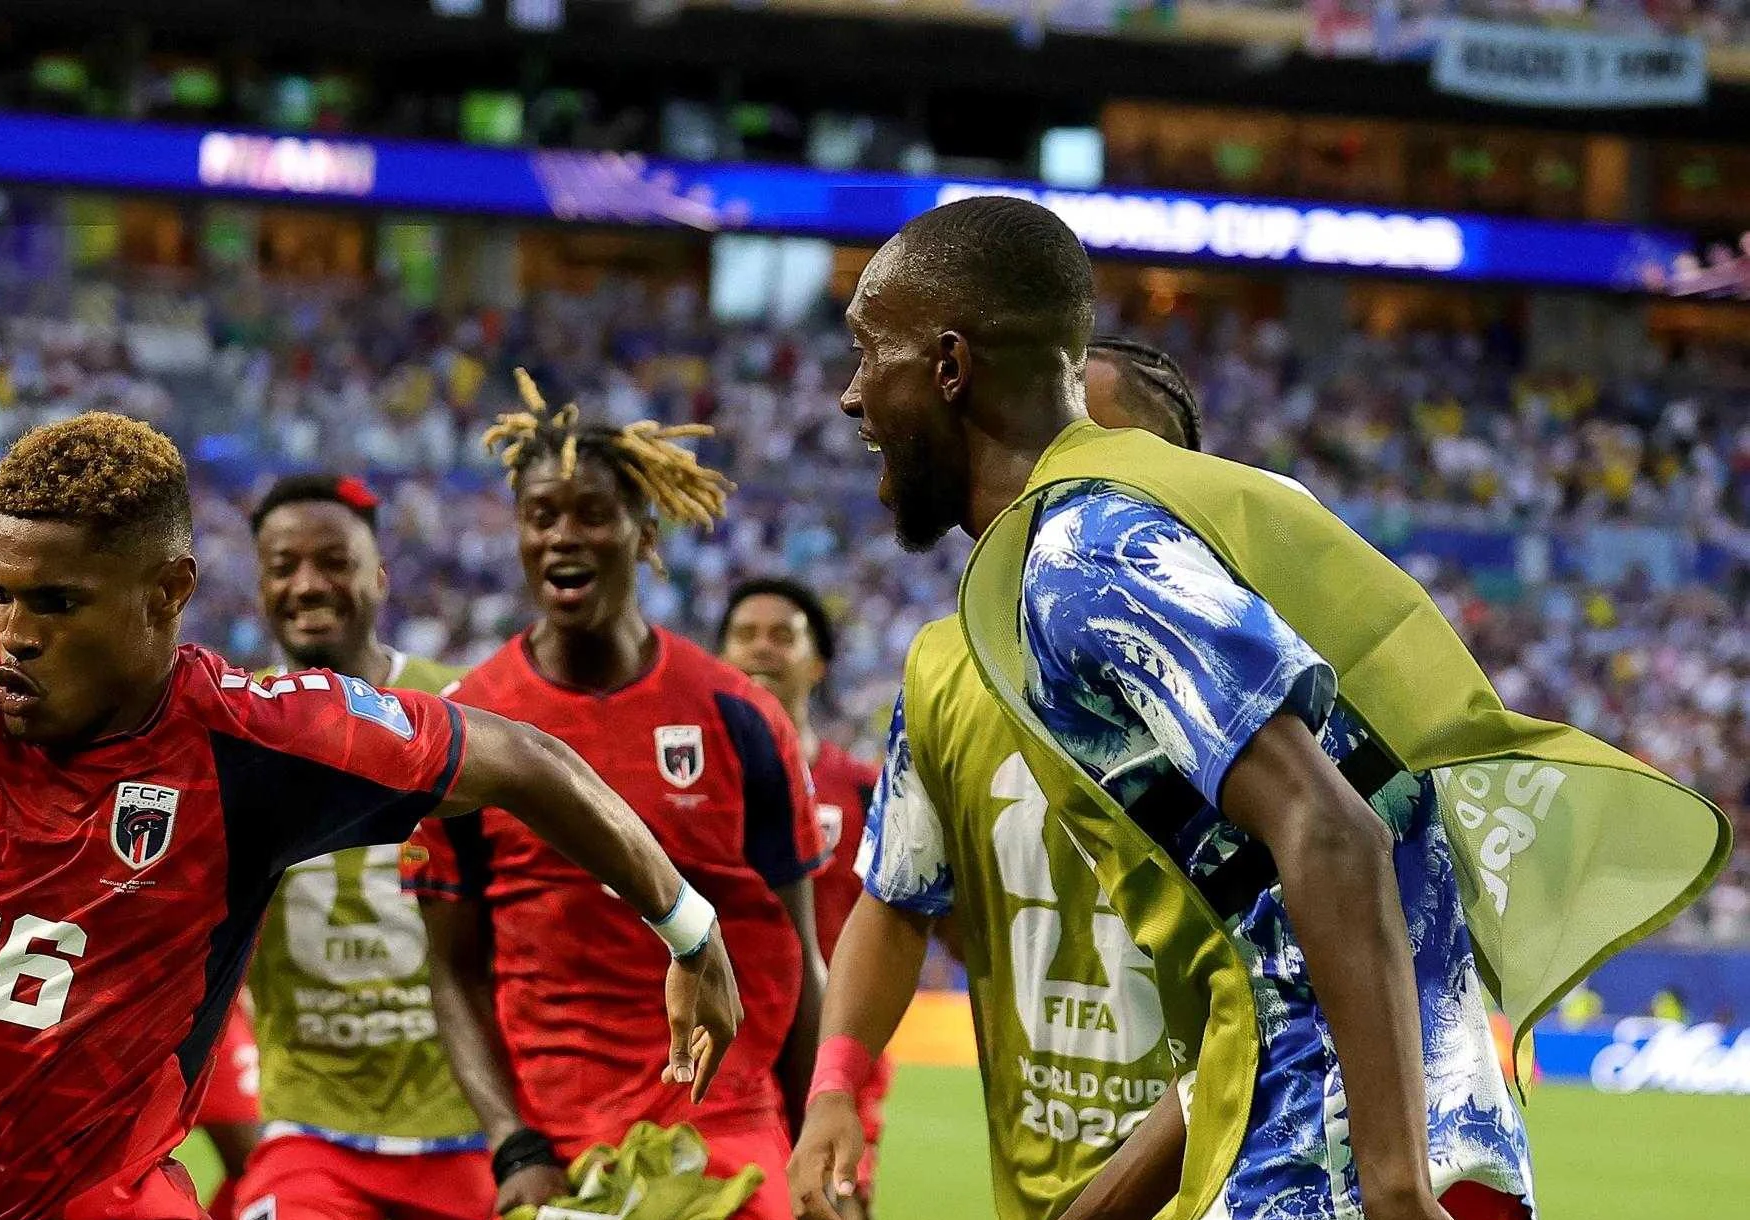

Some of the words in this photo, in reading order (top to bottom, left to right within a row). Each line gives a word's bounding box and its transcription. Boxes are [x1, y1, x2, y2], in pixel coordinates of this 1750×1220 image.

[122, 786, 175, 802] FCF
[1043, 994, 1118, 1034] FIFA
[1103, 1074, 1168, 1104] CUP
